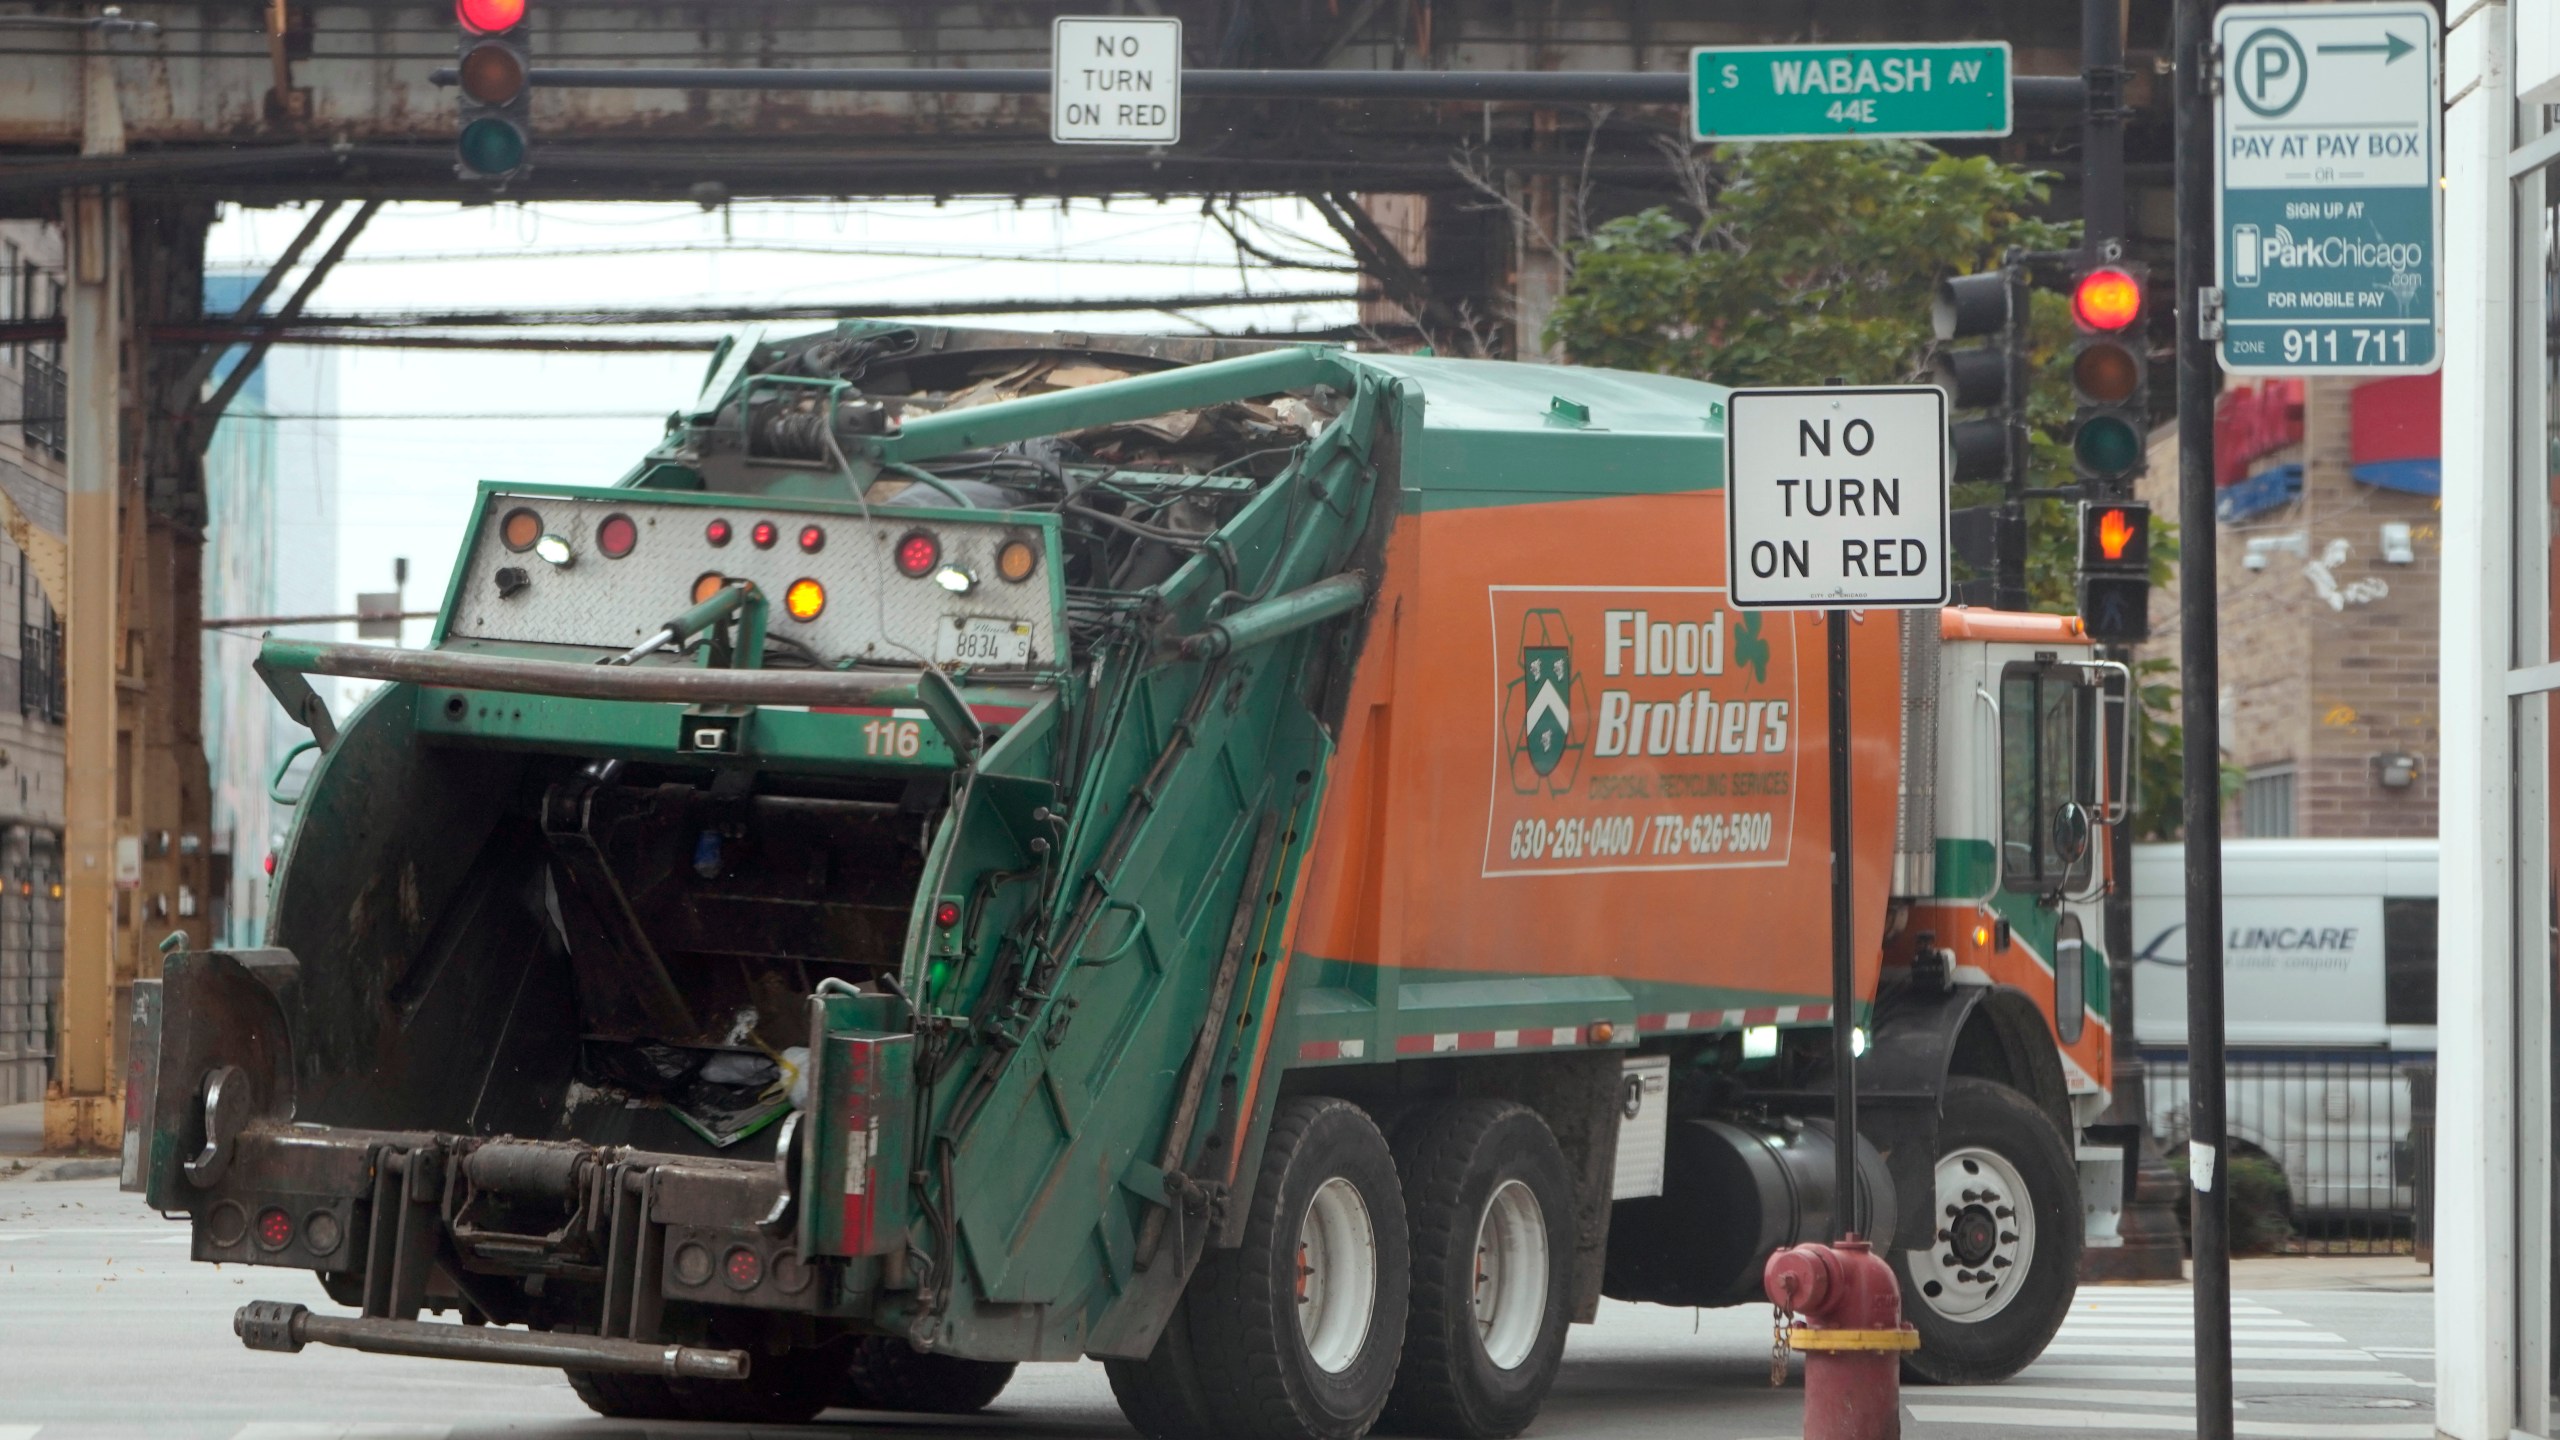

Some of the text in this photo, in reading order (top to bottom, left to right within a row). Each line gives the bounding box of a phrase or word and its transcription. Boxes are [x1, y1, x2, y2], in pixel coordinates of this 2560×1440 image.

[1095, 36, 1140, 57] NO
[1082, 70, 1152, 91] TURN
[1721, 57, 1982, 95] S WABASH AV
[1066, 104, 1167, 126] ON RED
[1826, 99, 1878, 123] 44E
[2232, 132, 2420, 158] PAY AT PAY BOX
[2315, 168, 2334, 182] OR
[2285, 202, 2365, 219] SIGN UP AT
[2262, 237, 2422, 273] ParkChicago
[2388, 272, 2422, 287] .com
[2267, 292, 2384, 308] FOR MOBILE PAY
[2233, 329, 2406, 363] ZONE 911 711
[1799, 418, 1875, 457] NO
[1776, 478, 1900, 517] TURN
[1751, 538, 1928, 578] ON RED
[956, 633, 1026, 659] 8834 S
[1603, 608, 1725, 677] Flood
[1593, 688, 1790, 758] Brothers
[863, 720, 920, 758] 116
[1657, 772, 1728, 798] RECYCLING
[1731, 770, 1790, 797] SERVICES
[2227, 927, 2359, 950] LINCARE
